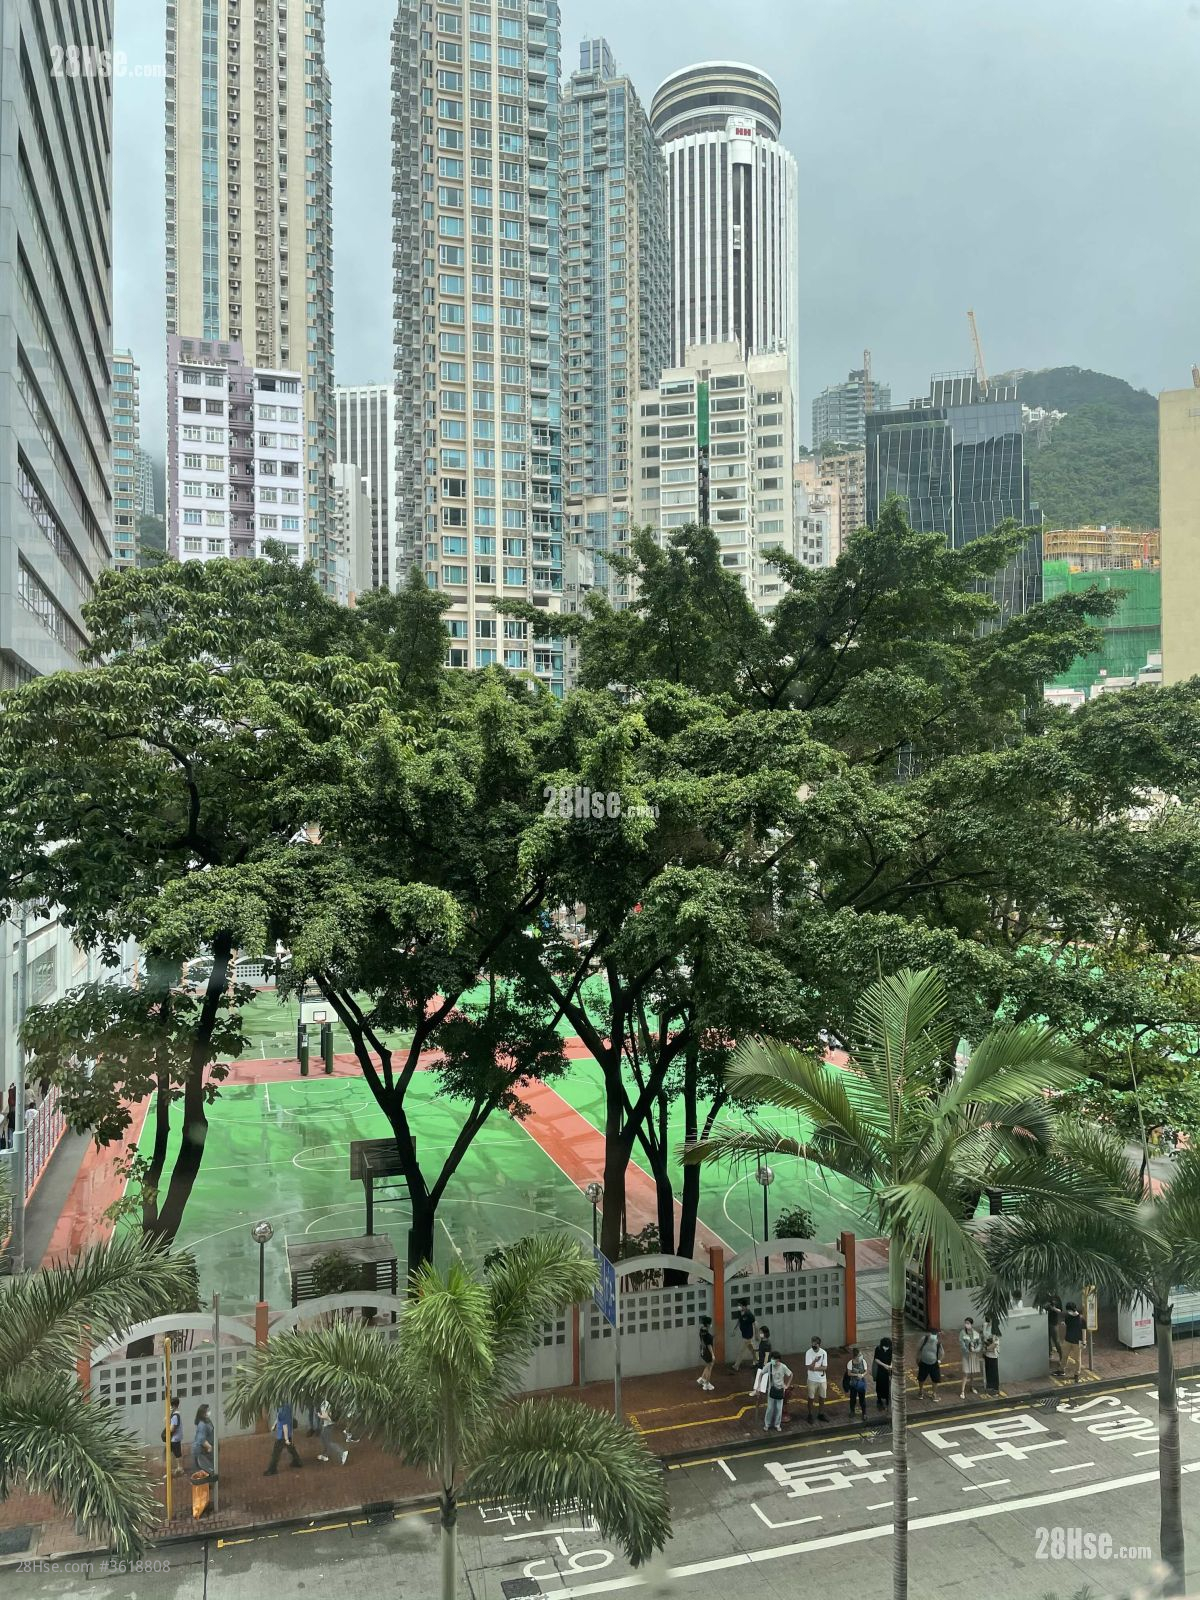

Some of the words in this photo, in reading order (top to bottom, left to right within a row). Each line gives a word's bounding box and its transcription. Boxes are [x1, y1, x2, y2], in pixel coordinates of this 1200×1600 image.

[921, 1414, 1069, 1469] 巴士
[1056, 1395, 1160, 1442] STOP
[763, 1449, 911, 1498] 站
